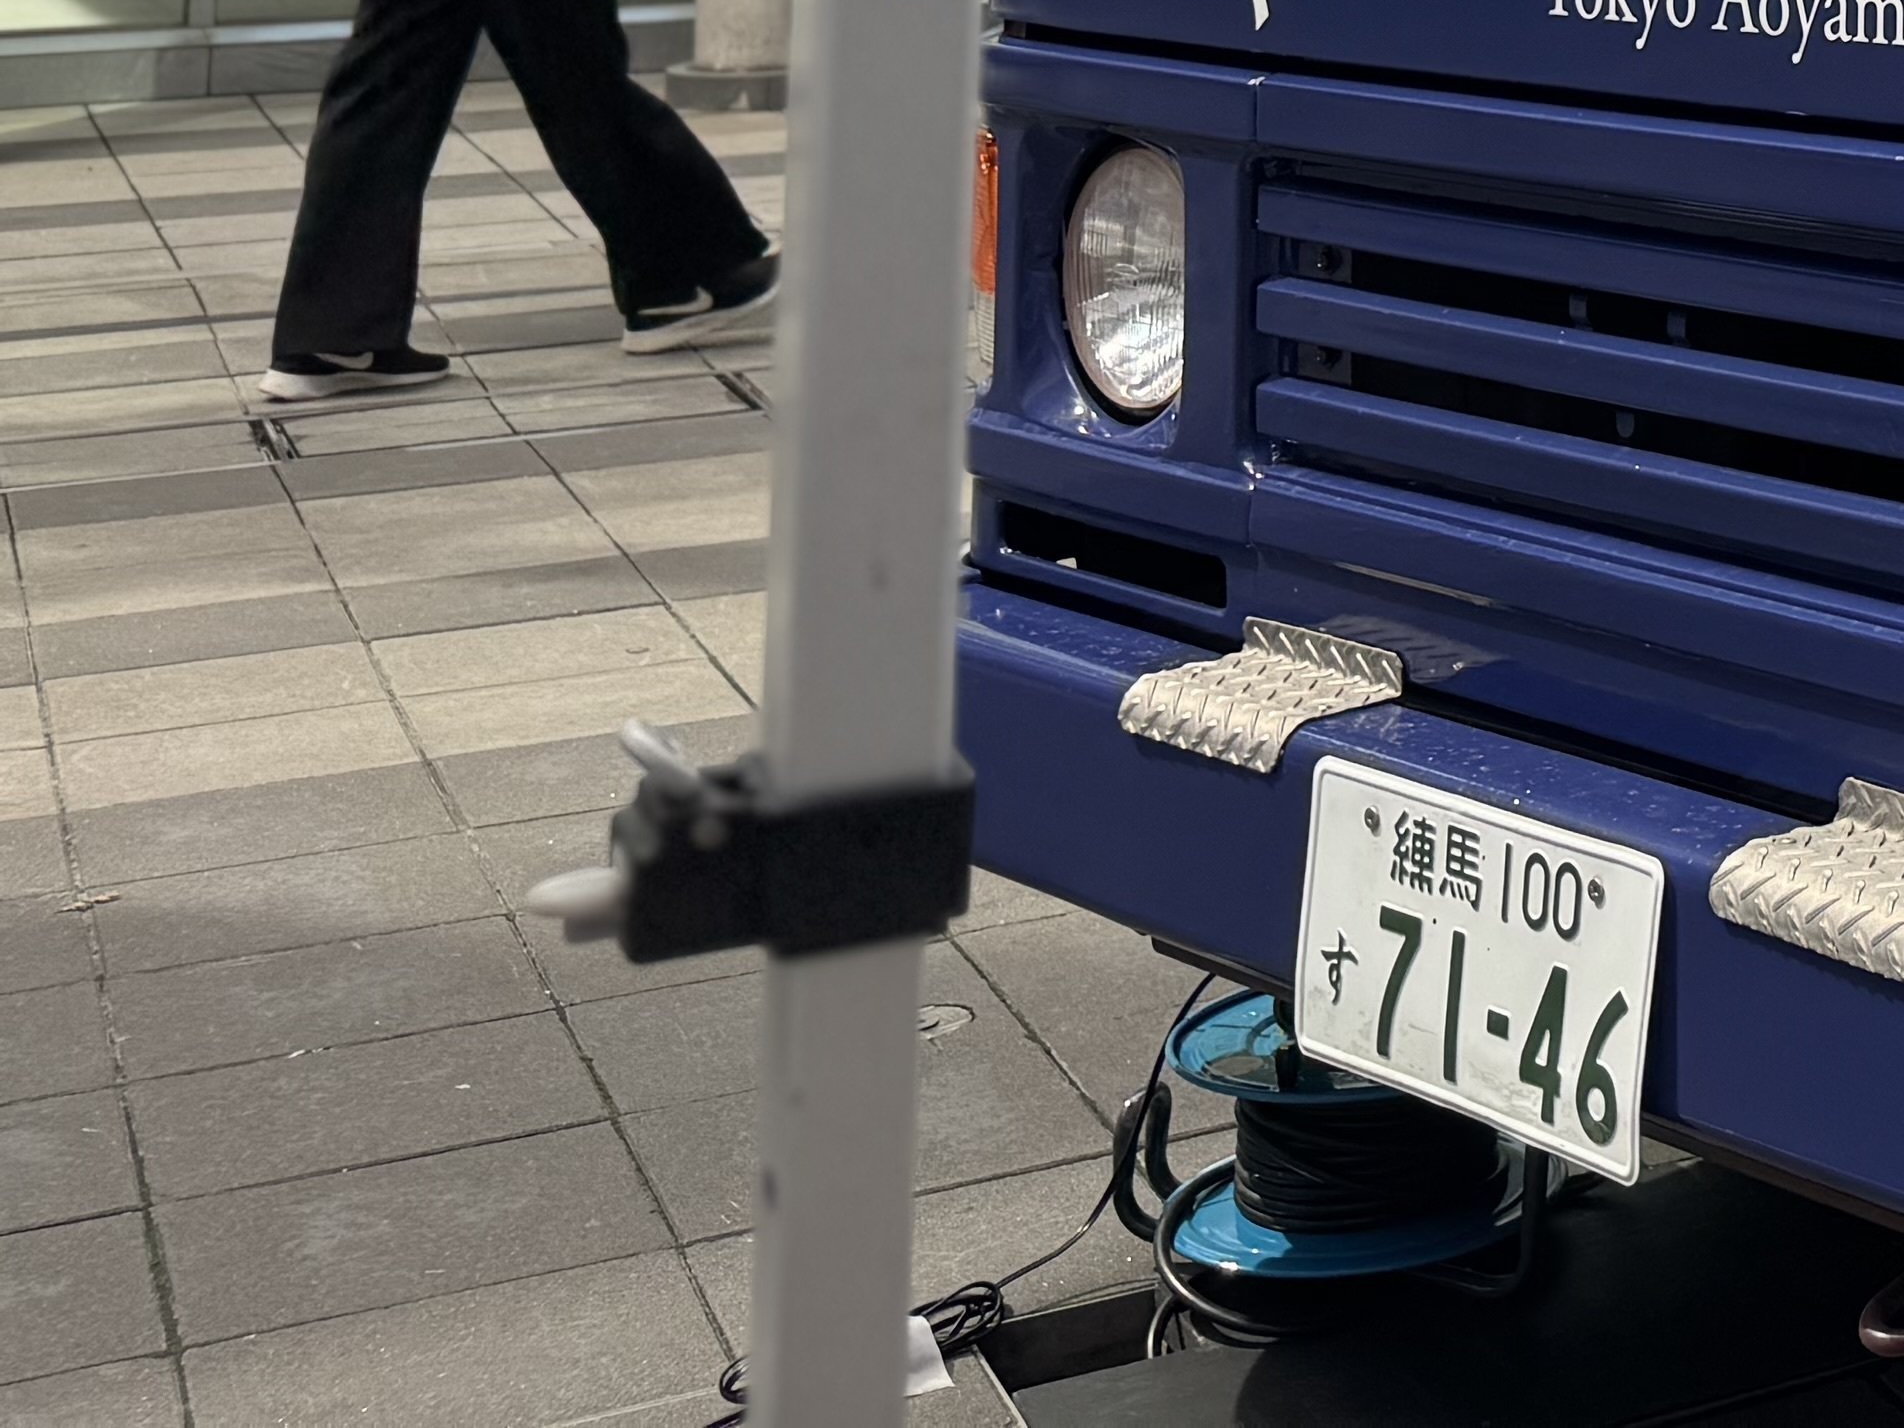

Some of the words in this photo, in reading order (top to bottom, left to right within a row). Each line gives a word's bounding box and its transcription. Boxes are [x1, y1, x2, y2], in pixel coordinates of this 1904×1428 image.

[1390, 809, 1484, 912] 練馬
[1501, 842, 1584, 942] 100
[1320, 930, 1359, 1005] す
[1376, 903, 1630, 1147] 71-46
